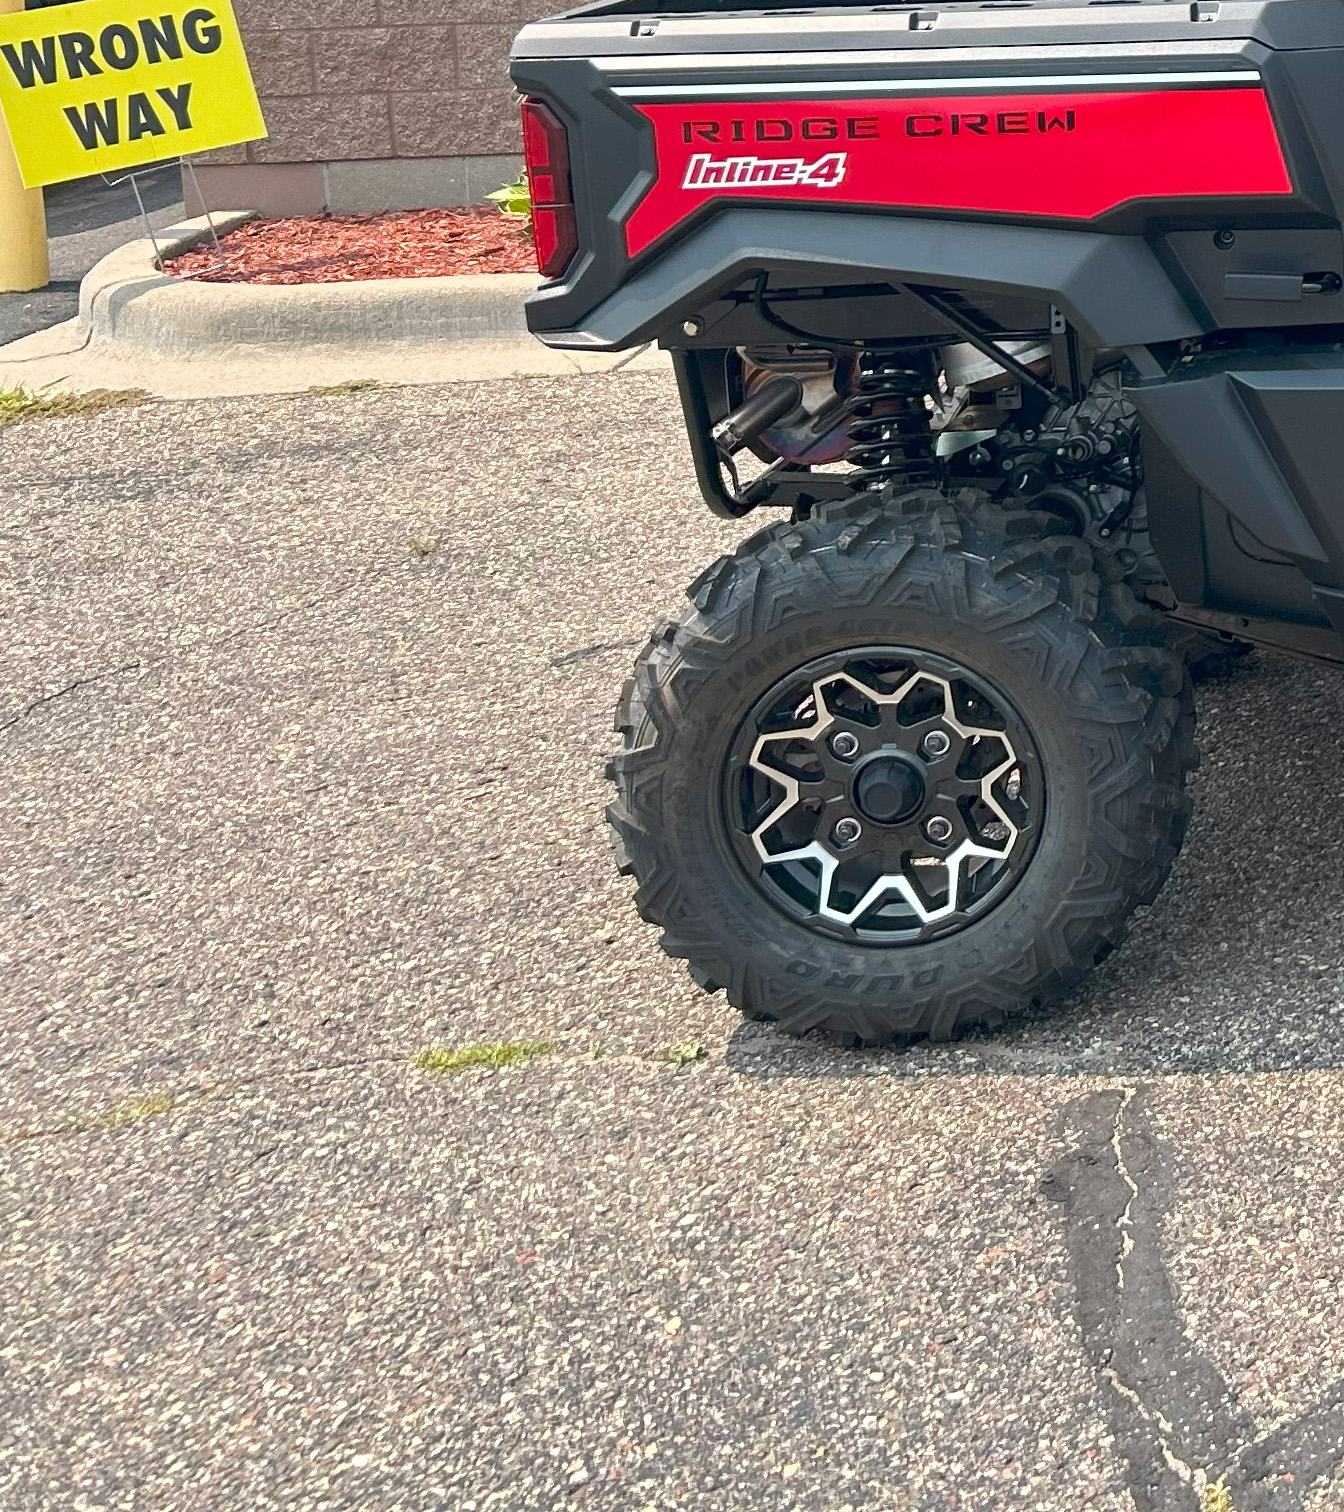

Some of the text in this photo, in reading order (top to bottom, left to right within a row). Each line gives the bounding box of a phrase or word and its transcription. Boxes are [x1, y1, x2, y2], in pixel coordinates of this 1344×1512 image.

[0, 8, 222, 89] WRONG
[62, 82, 193, 150] WAY
[682, 110, 1077, 143] RIDGE CREW
[683, 152, 848, 189] Inline-4
[785, 959, 944, 995] DURO
